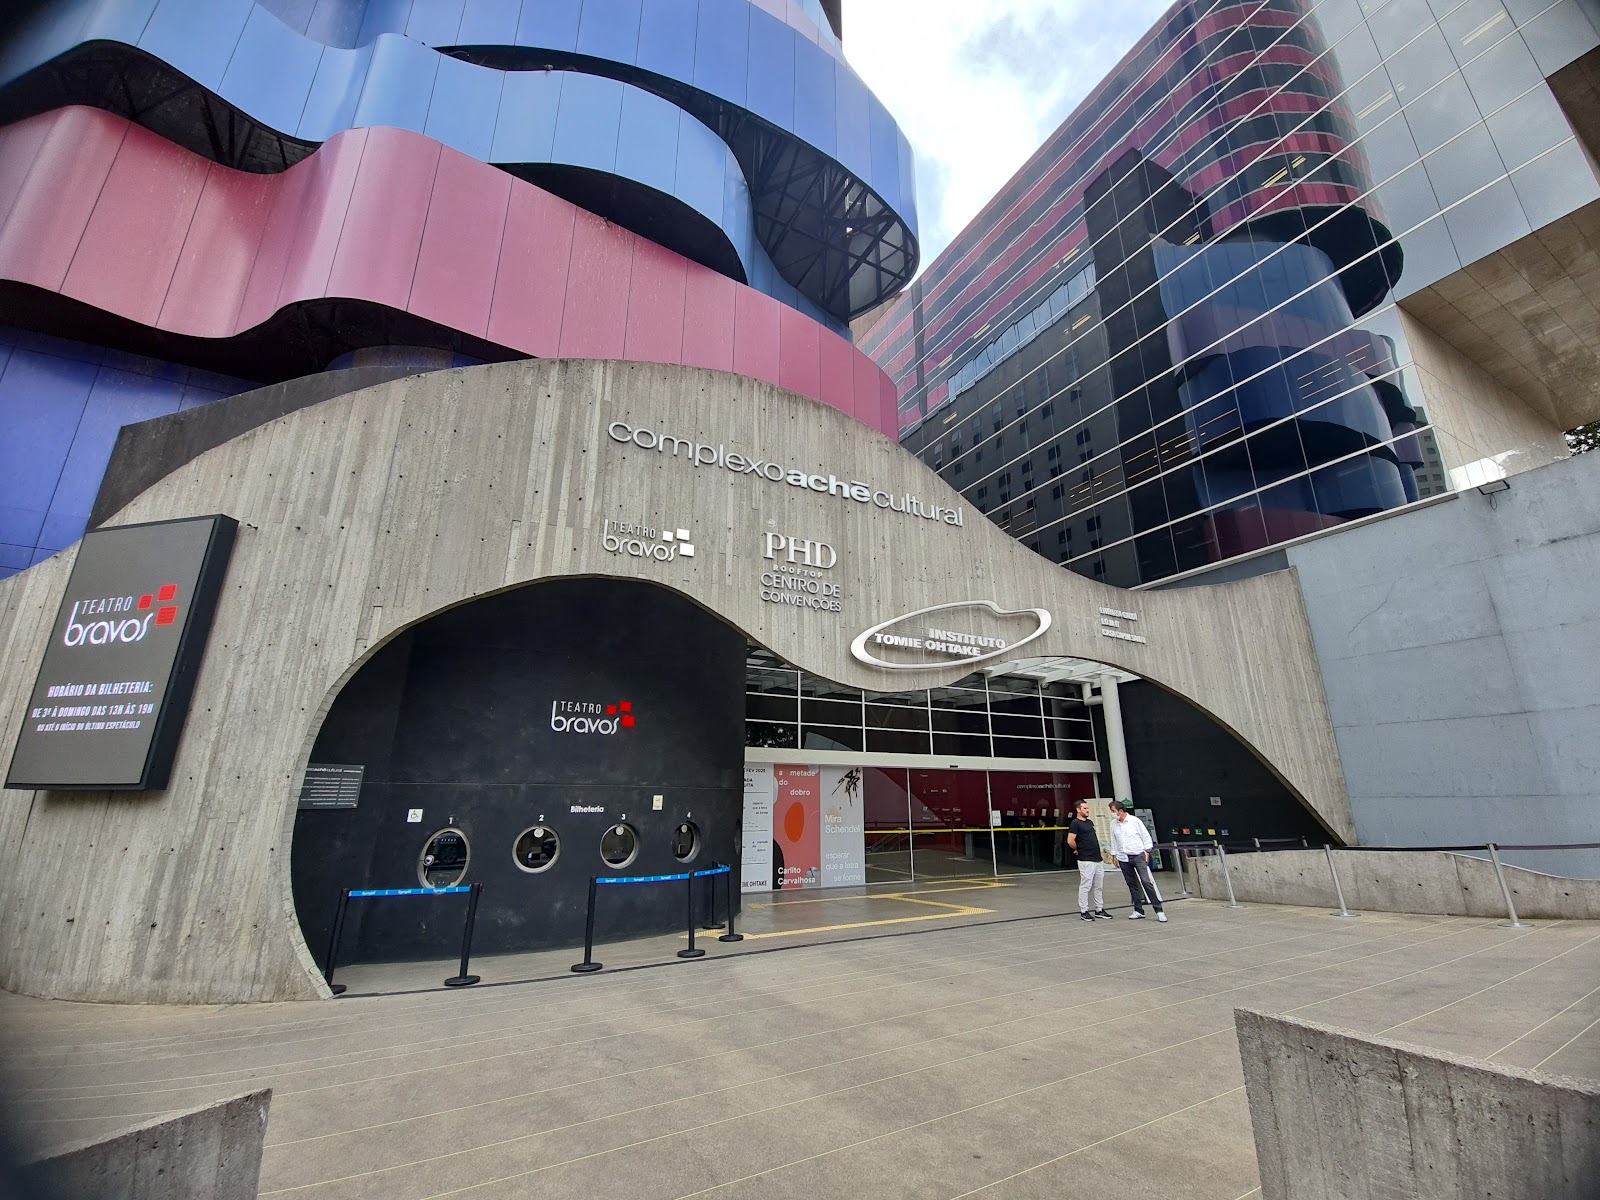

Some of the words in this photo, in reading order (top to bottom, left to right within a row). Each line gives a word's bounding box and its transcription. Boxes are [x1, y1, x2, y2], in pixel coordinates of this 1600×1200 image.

[612, 520, 657, 540] TEATRO
[602, 519, 678, 562] bravos
[763, 531, 838, 570] PHD
[773, 564, 823, 578] ROOFTOP
[760, 572, 820, 594] CENTRO
[822, 582, 841, 598] DE
[82, 596, 133, 615] TEATRO
[760, 589, 842, 612] CONVENÇÕES
[64, 601, 154, 647] bravos
[874, 633, 922, 648] TOMIE
[924, 640, 982, 656] OHTAKE
[928, 628, 1006, 649] INSTITUTO
[47, 683, 83, 698] HORÁRIO
[84, 684, 98, 696] DA
[97, 681, 154, 696] BILHETERIA:
[31, 707, 44, 718] DE
[58, 705, 91, 717] DOMINGO
[91, 705, 107, 716] DAS
[108, 704, 125, 715] 13H
[137, 703, 154, 715] 19H
[560, 701, 602, 715] TEATRO
[105, 719, 141, 730] ESPETÁCULO
[550, 701, 620, 735] bravos
[790, 769, 816, 777] metade
[570, 805, 604, 813] Bilheteria
[686, 811, 692, 819] 4
[448, 817, 454, 825] 1
[538, 814, 545, 822] 2
[824, 814, 842, 823] Mira
[825, 824, 860, 834] Schendel
[825, 852, 850, 860] esperar
[778, 867, 801, 875] Carlito
[825, 863, 838, 871] que
[844, 861, 859, 869] letra
[778, 876, 816, 886] Carvalhosa
[842, 873, 861, 881] forma
